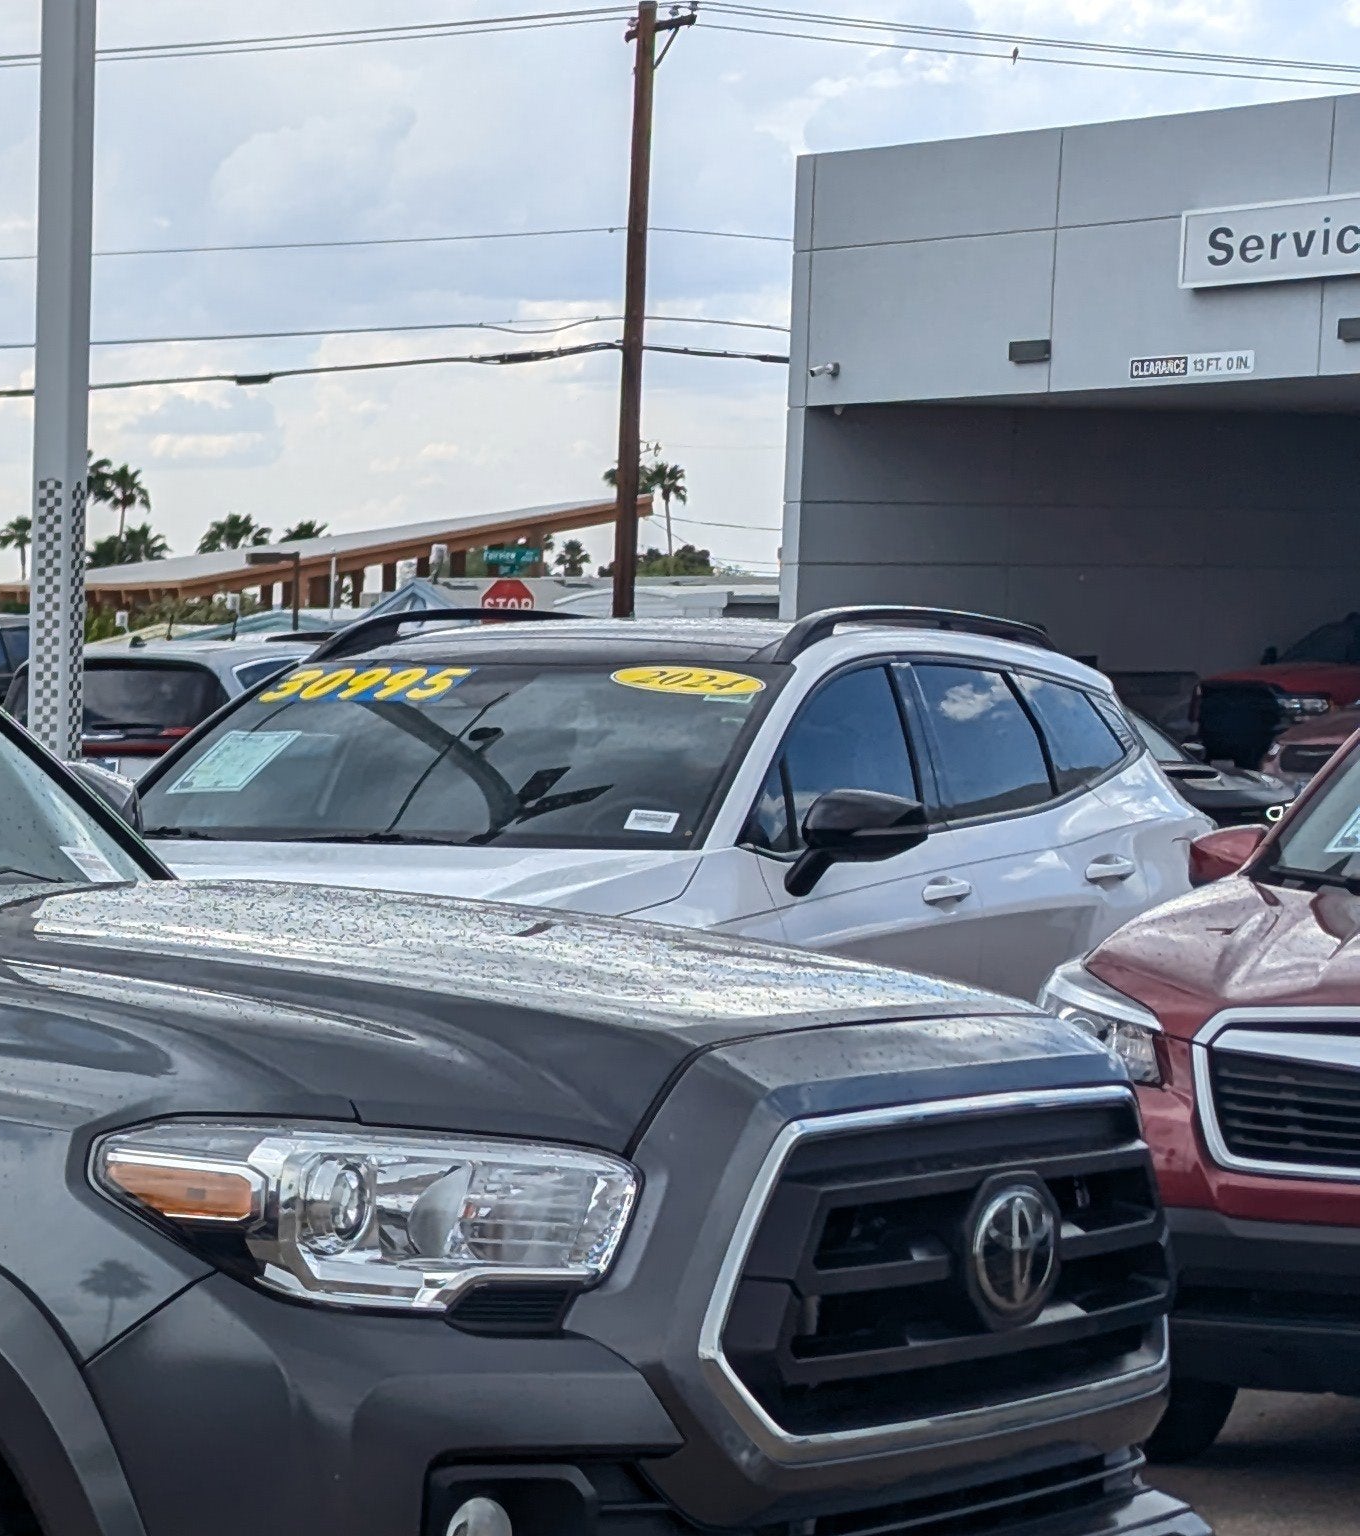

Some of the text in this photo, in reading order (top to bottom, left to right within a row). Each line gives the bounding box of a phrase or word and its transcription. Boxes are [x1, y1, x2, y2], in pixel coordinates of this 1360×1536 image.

[1207, 216, 1360, 266] Servic
[1132, 358, 1186, 376] CLEARANCE
[1193, 357, 1204, 371] 13
[484, 598, 532, 610] STOP
[258, 667, 473, 703] 30995
[632, 670, 747, 691] 2024
